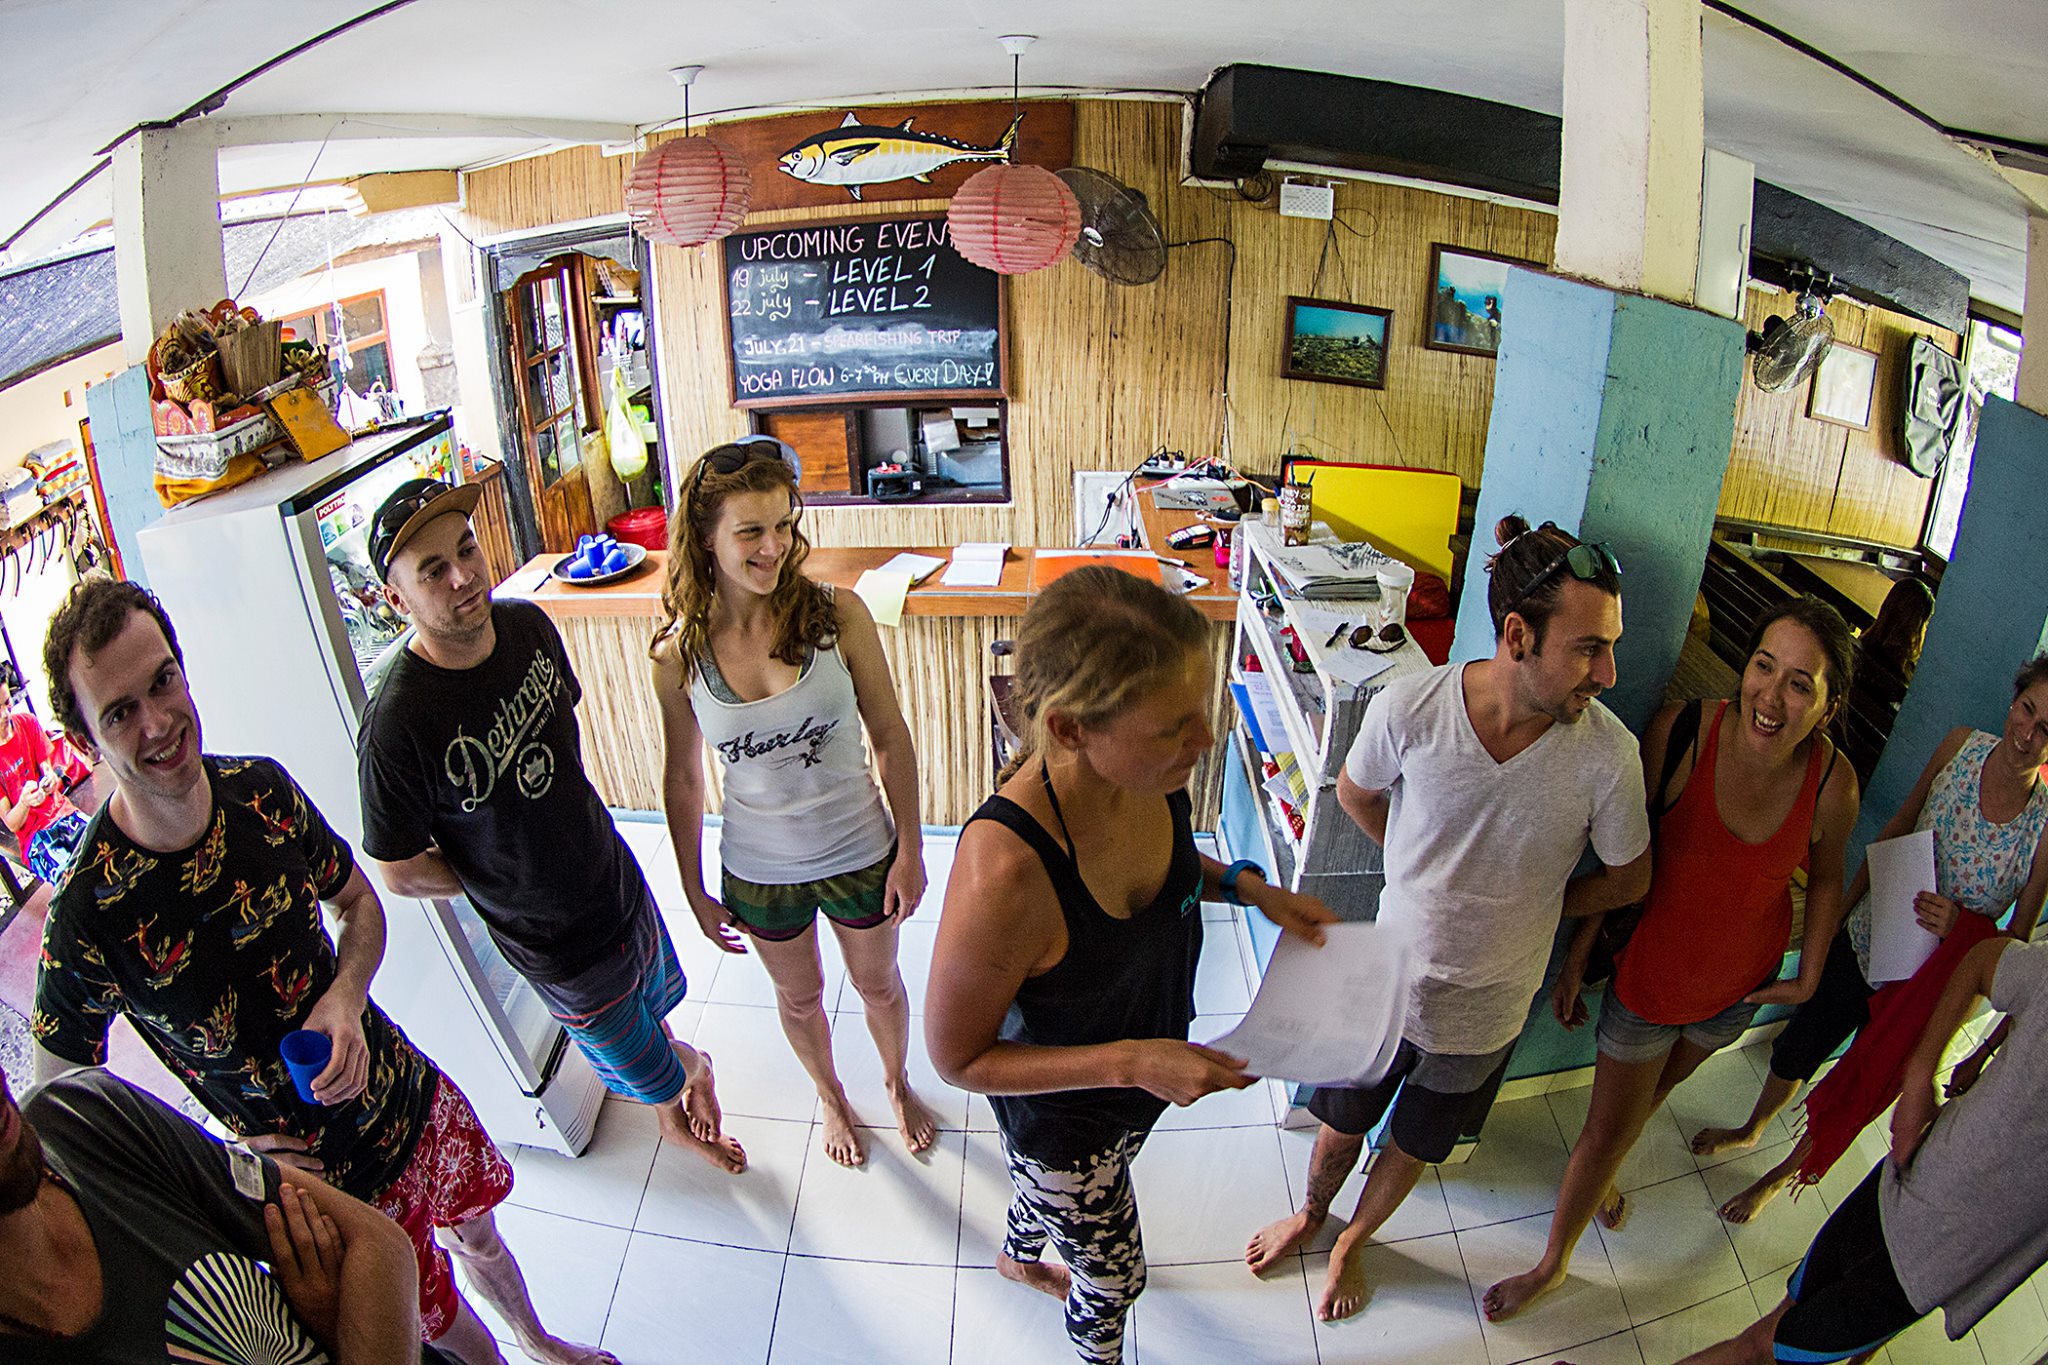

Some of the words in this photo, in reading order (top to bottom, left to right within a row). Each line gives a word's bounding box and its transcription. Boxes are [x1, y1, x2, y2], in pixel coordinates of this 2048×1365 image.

[741, 226, 865, 260] UPCOMING
[877, 221, 955, 249] EVEN
[732, 268, 749, 288] 19
[759, 267, 789, 293] july
[833, 255, 912, 284] LEVEL
[918, 253, 936, 280] 1
[731, 300, 751, 317] 22
[755, 291, 792, 321] july
[830, 286, 909, 316] LEVEL
[913, 285, 932, 308] 2
[824, 330, 922, 350] SPEARFISHING
[928, 329, 961, 346] TRIP
[739, 369, 783, 394] YOGA
[791, 367, 835, 389] FLOW
[894, 362, 939, 387] EVERY
[445, 649, 554, 813] Dethrone
[717, 716, 840, 764] Hurley
